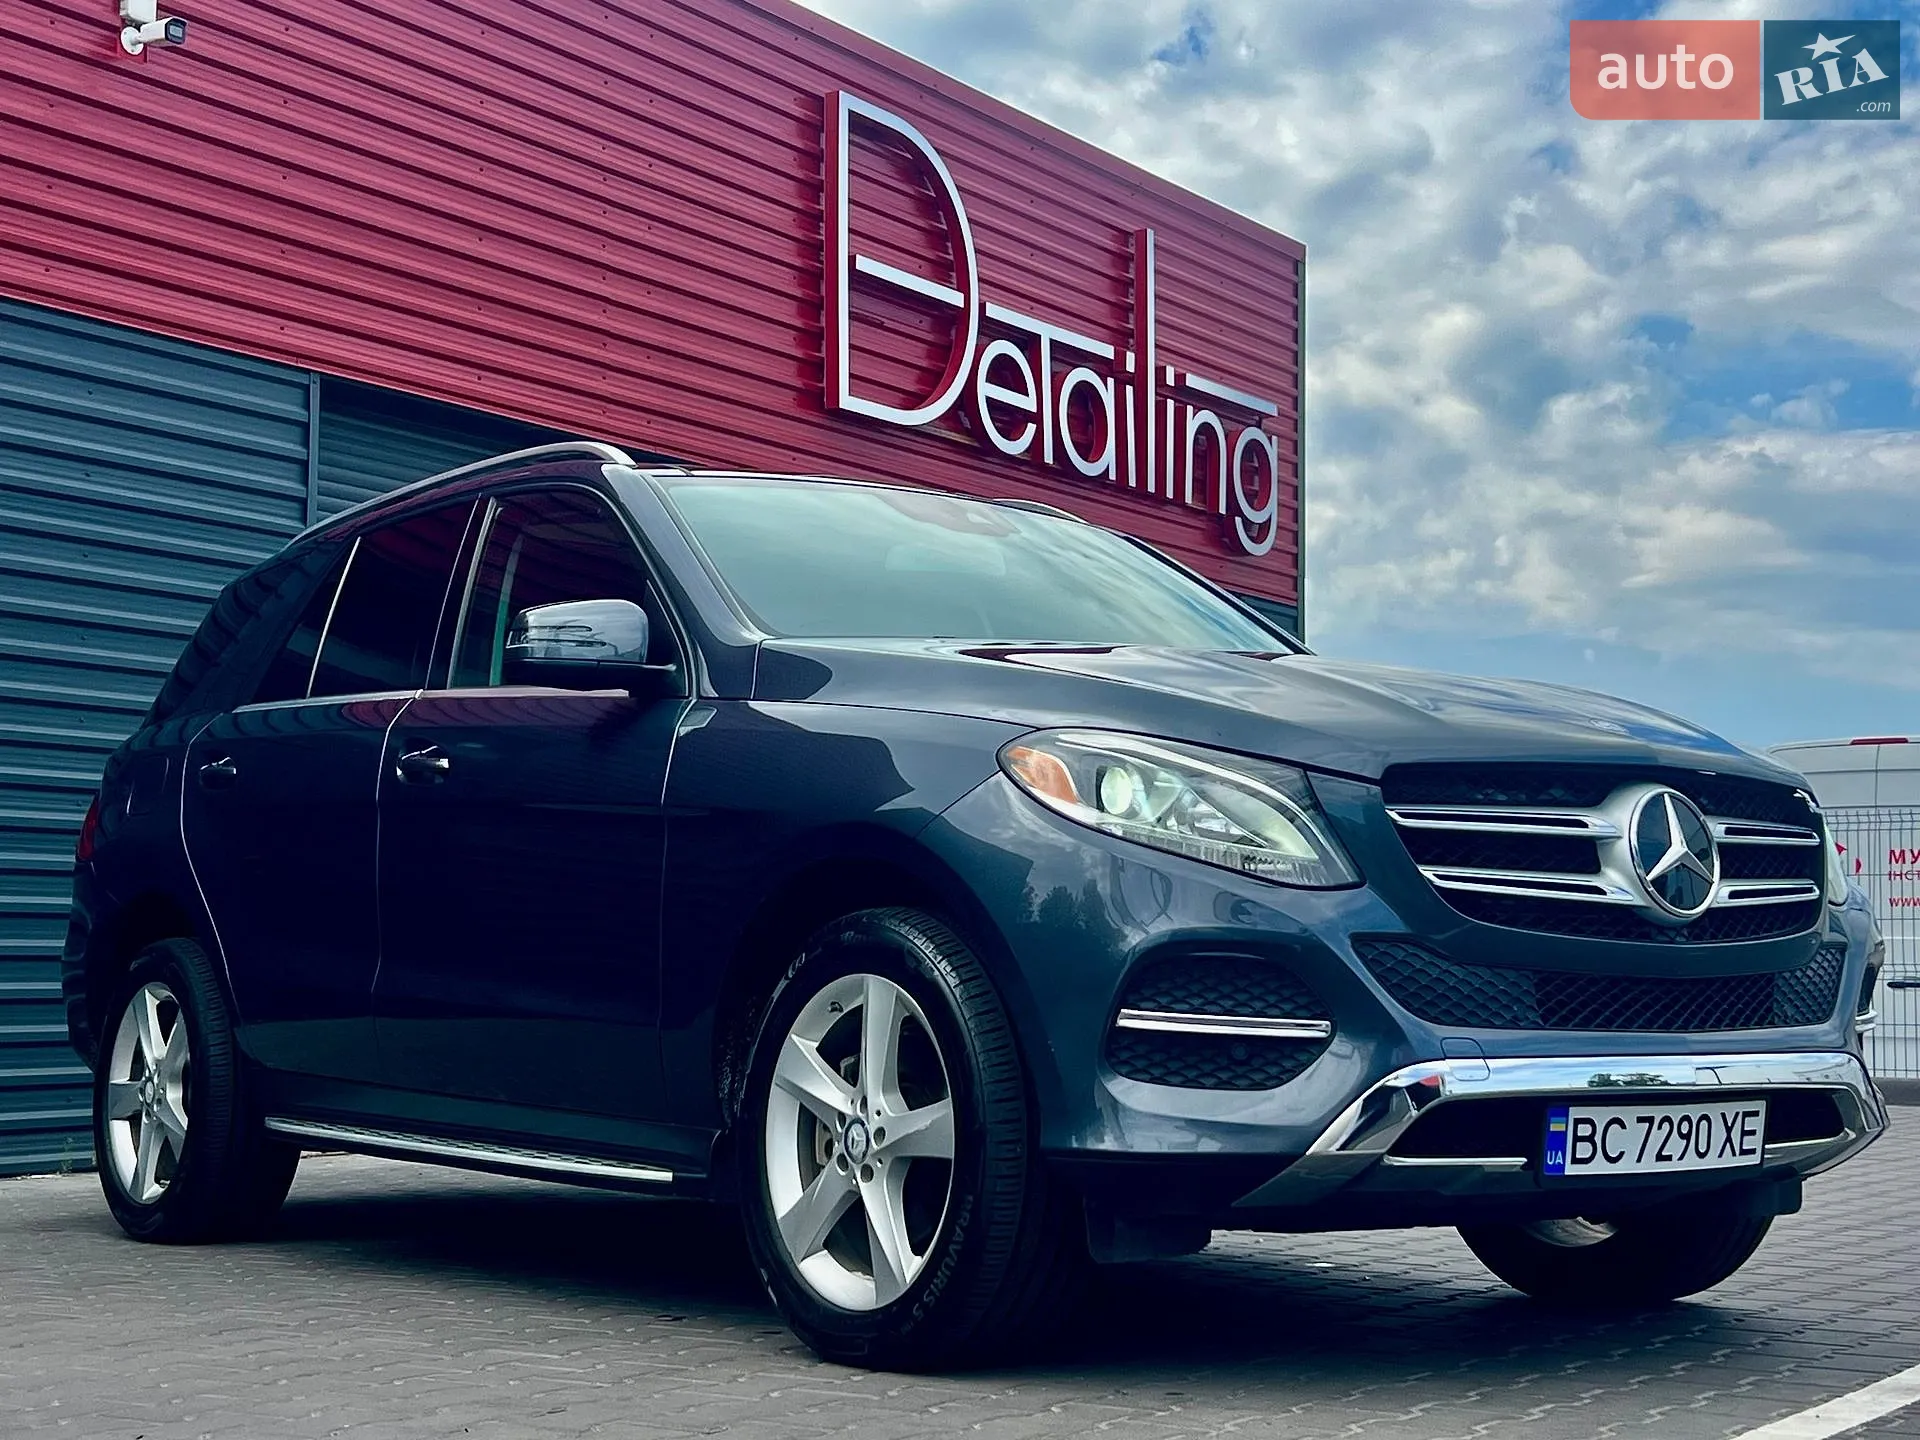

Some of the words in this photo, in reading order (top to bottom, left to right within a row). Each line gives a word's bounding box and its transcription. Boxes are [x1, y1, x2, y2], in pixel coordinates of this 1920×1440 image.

[1570, 1116, 1627, 1165] BC
[1636, 1113, 1712, 1163] 7290
[1718, 1110, 1760, 1158] XE
[1547, 1150, 1563, 1165] UA
